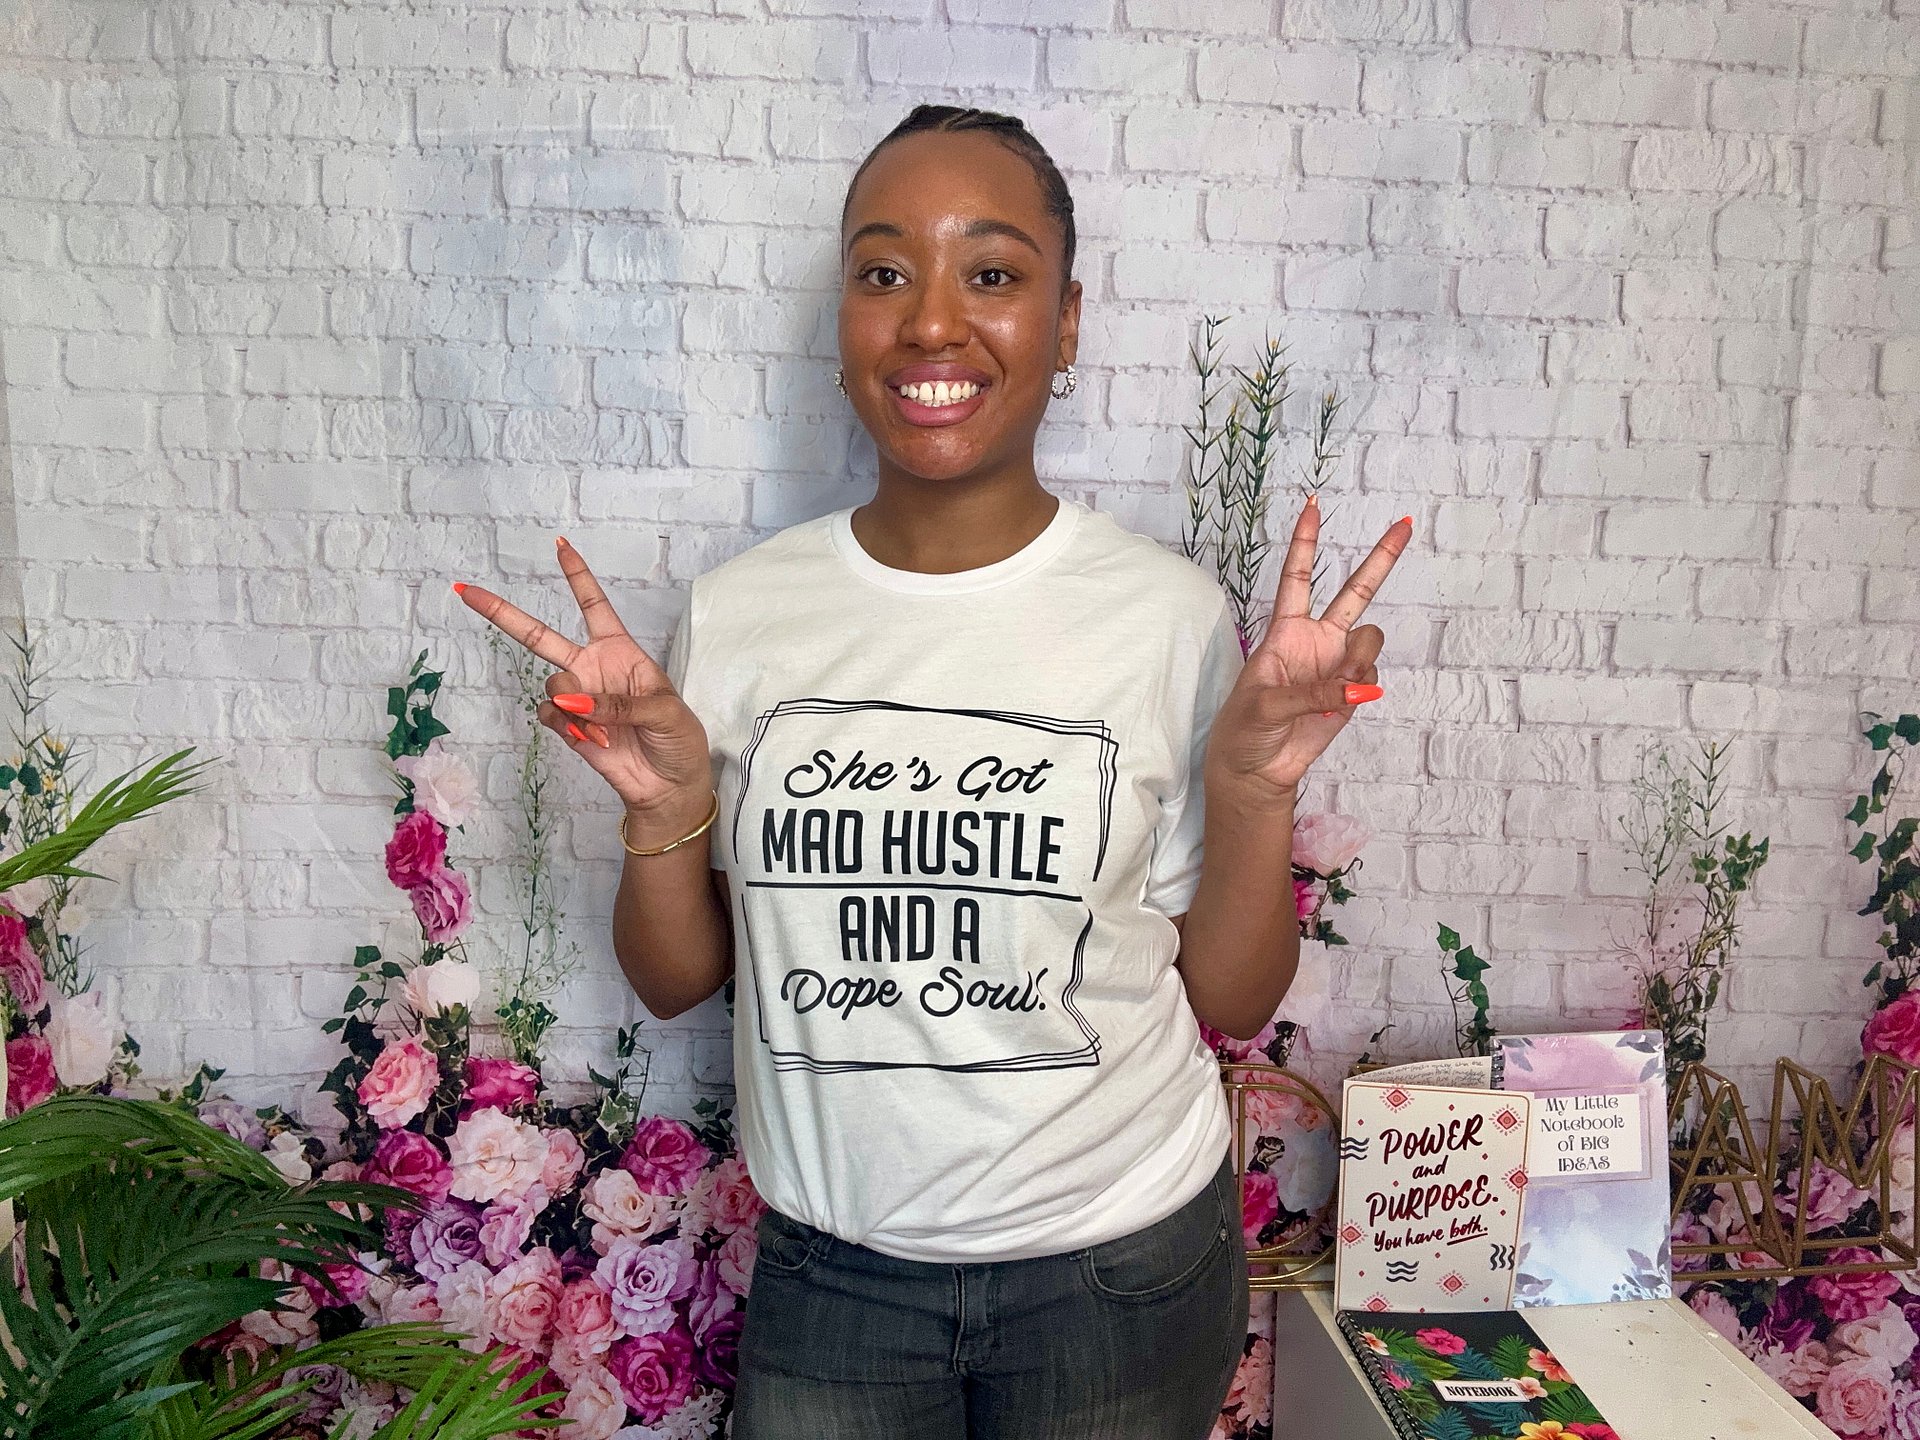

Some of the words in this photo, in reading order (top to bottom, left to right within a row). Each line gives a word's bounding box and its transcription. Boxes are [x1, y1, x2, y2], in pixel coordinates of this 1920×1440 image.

[784, 749, 941, 798] She's
[957, 756, 1054, 801] Got
[762, 808, 864, 874] MAD
[883, 810, 1064, 884] HUSTLE
[839, 895, 935, 963] AND
[952, 897, 980, 964] A
[781, 968, 902, 1021] Dope
[1541, 1114, 1625, 1133] Notebook
[1545, 1097, 1568, 1116] My
[1575, 1095, 1619, 1110] Little
[1379, 1113, 1484, 1165] POWER
[1557, 1134, 1575, 1152] of
[1581, 1135, 1610, 1150] BIG
[1412, 1154, 1449, 1180] and
[1558, 1156, 1610, 1172] IDEAS
[1365, 1174, 1499, 1228] PURPOSE.
[1374, 1230, 1402, 1252] You
[1405, 1228, 1445, 1247] have
[1449, 1214, 1488, 1239] both.
[1445, 1385, 1519, 1397] NOTEBOOK
